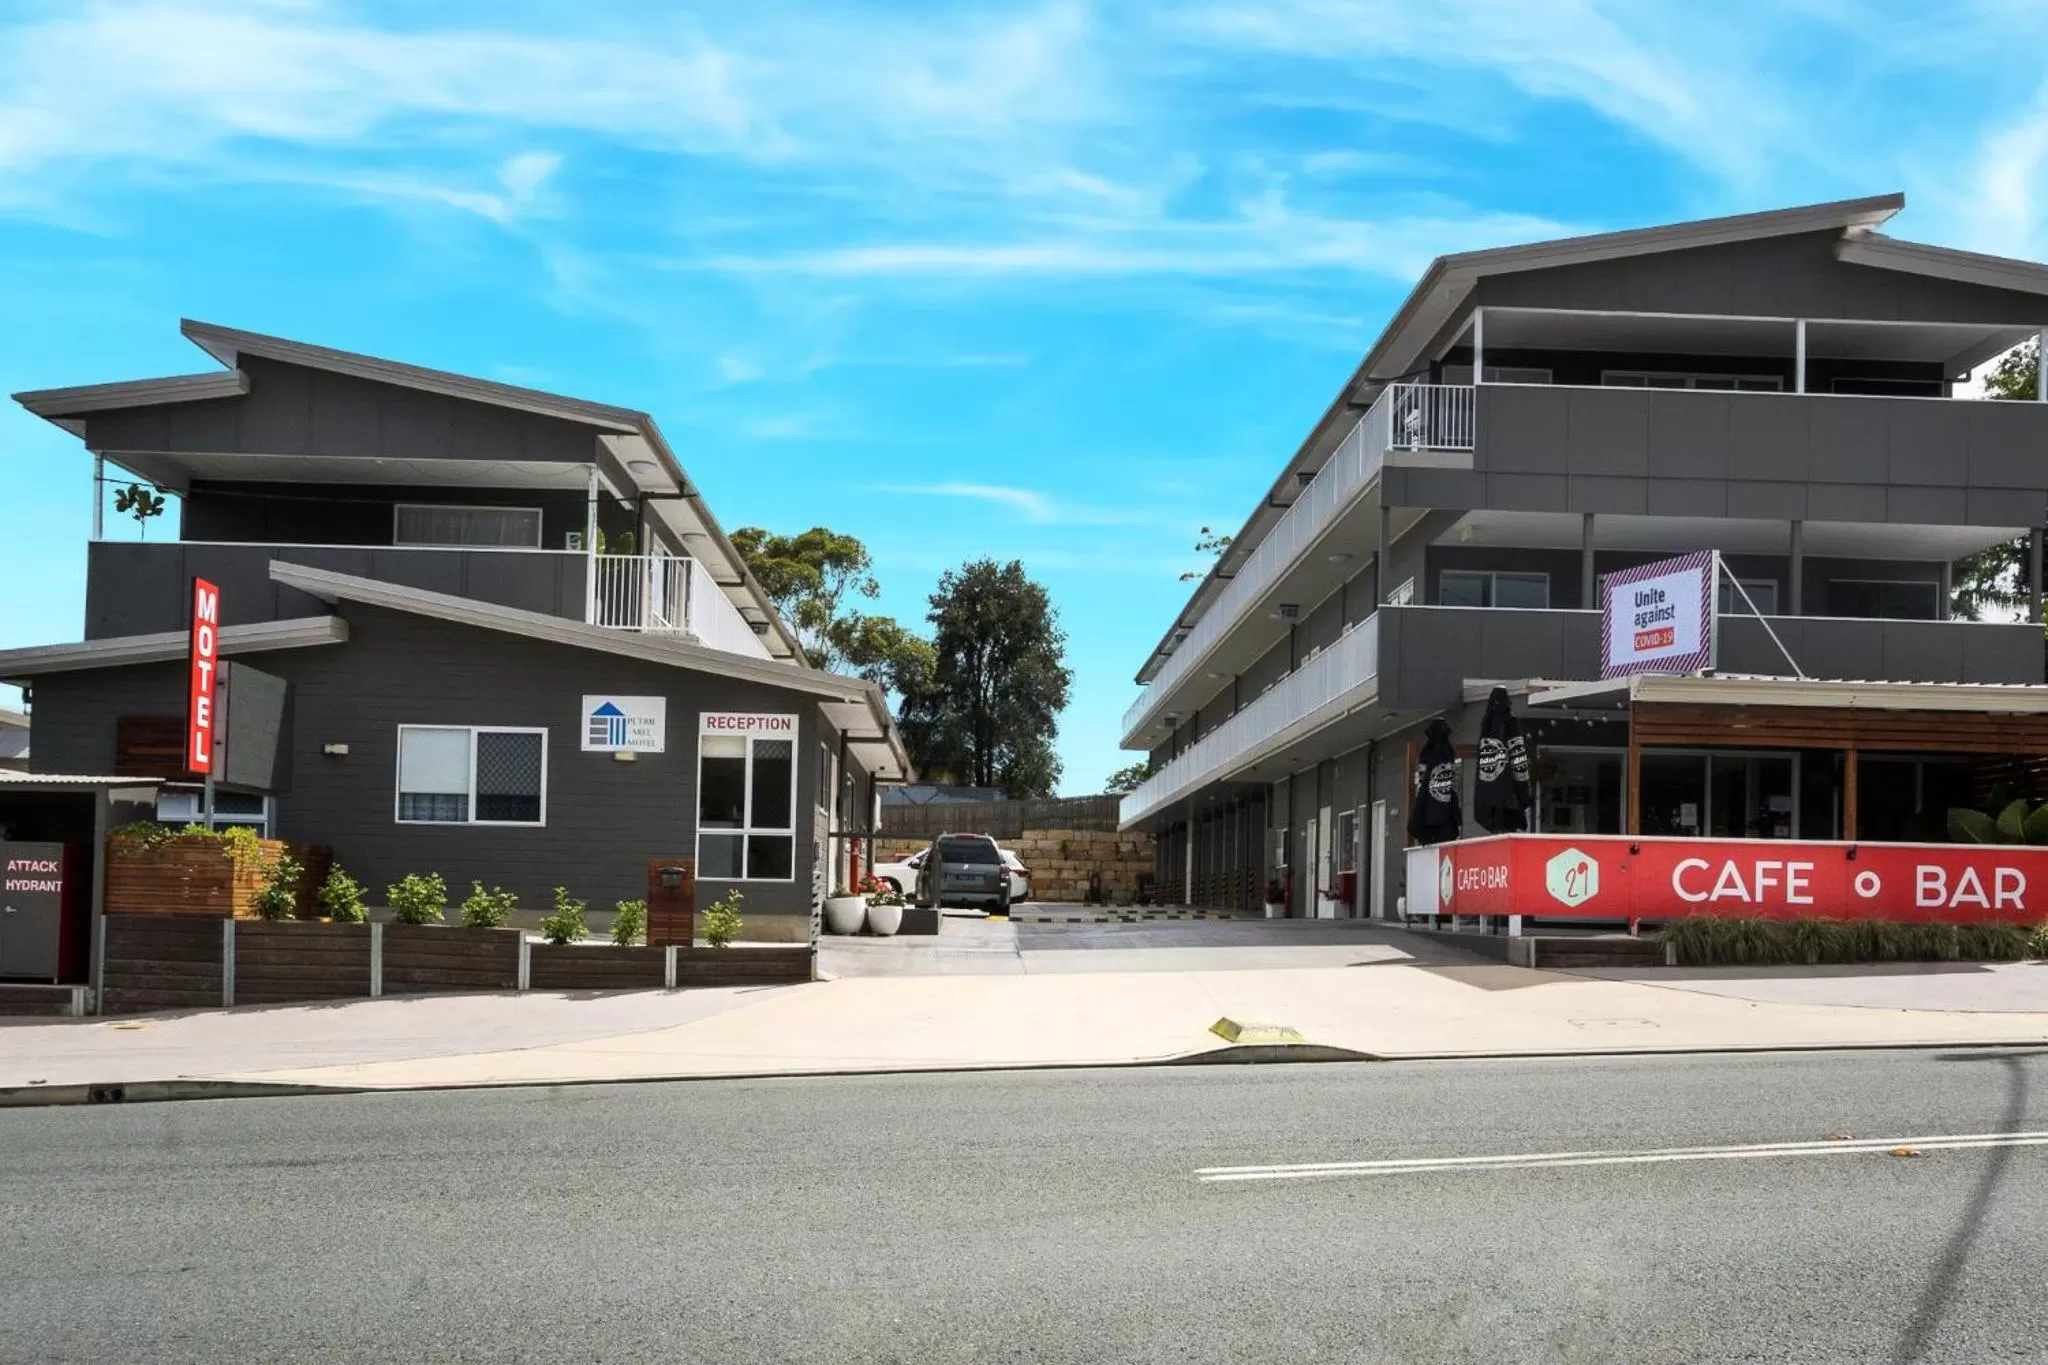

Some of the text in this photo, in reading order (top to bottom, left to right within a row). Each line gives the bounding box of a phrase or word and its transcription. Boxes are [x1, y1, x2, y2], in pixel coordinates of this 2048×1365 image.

[1634, 588, 1666, 608] Unite
[1634, 604, 1676, 628] against
[1635, 630, 1674, 649] COVID-19
[195, 587, 217, 764] MOTEL
[706, 716, 792, 730] RECEPTION
[7, 860, 58, 872] ATTACK
[5, 879, 63, 892] HYDRANT
[1457, 868, 1479, 890] CAFE
[1487, 865, 1508, 889] BAR
[1672, 857, 1815, 905] CAFE
[1915, 864, 2027, 910] BAR
